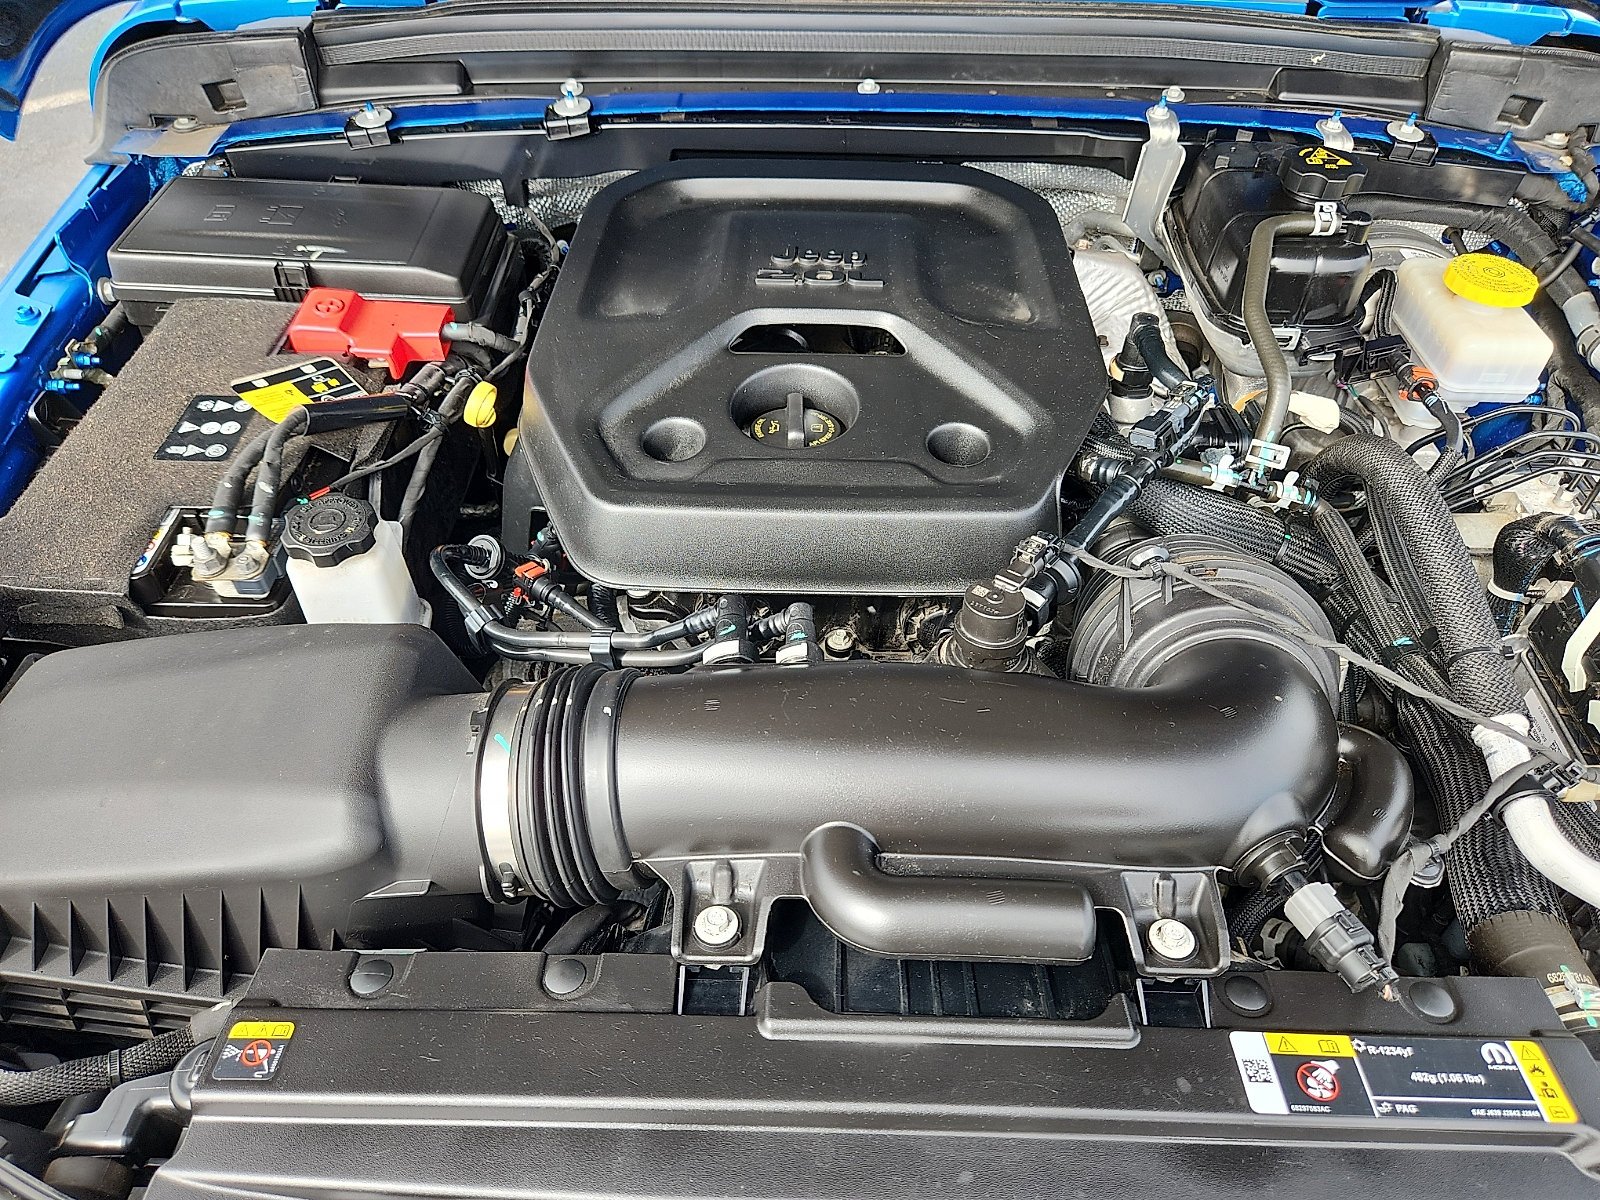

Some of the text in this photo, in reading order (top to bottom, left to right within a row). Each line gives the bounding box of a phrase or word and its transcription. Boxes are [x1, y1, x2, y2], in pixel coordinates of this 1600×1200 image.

[770, 245, 868, 270] Jeep
[754, 268, 886, 288] 2.0L
[1366, 1045, 1415, 1058] R-1234yf
[1395, 1103, 1419, 1114] PAG
